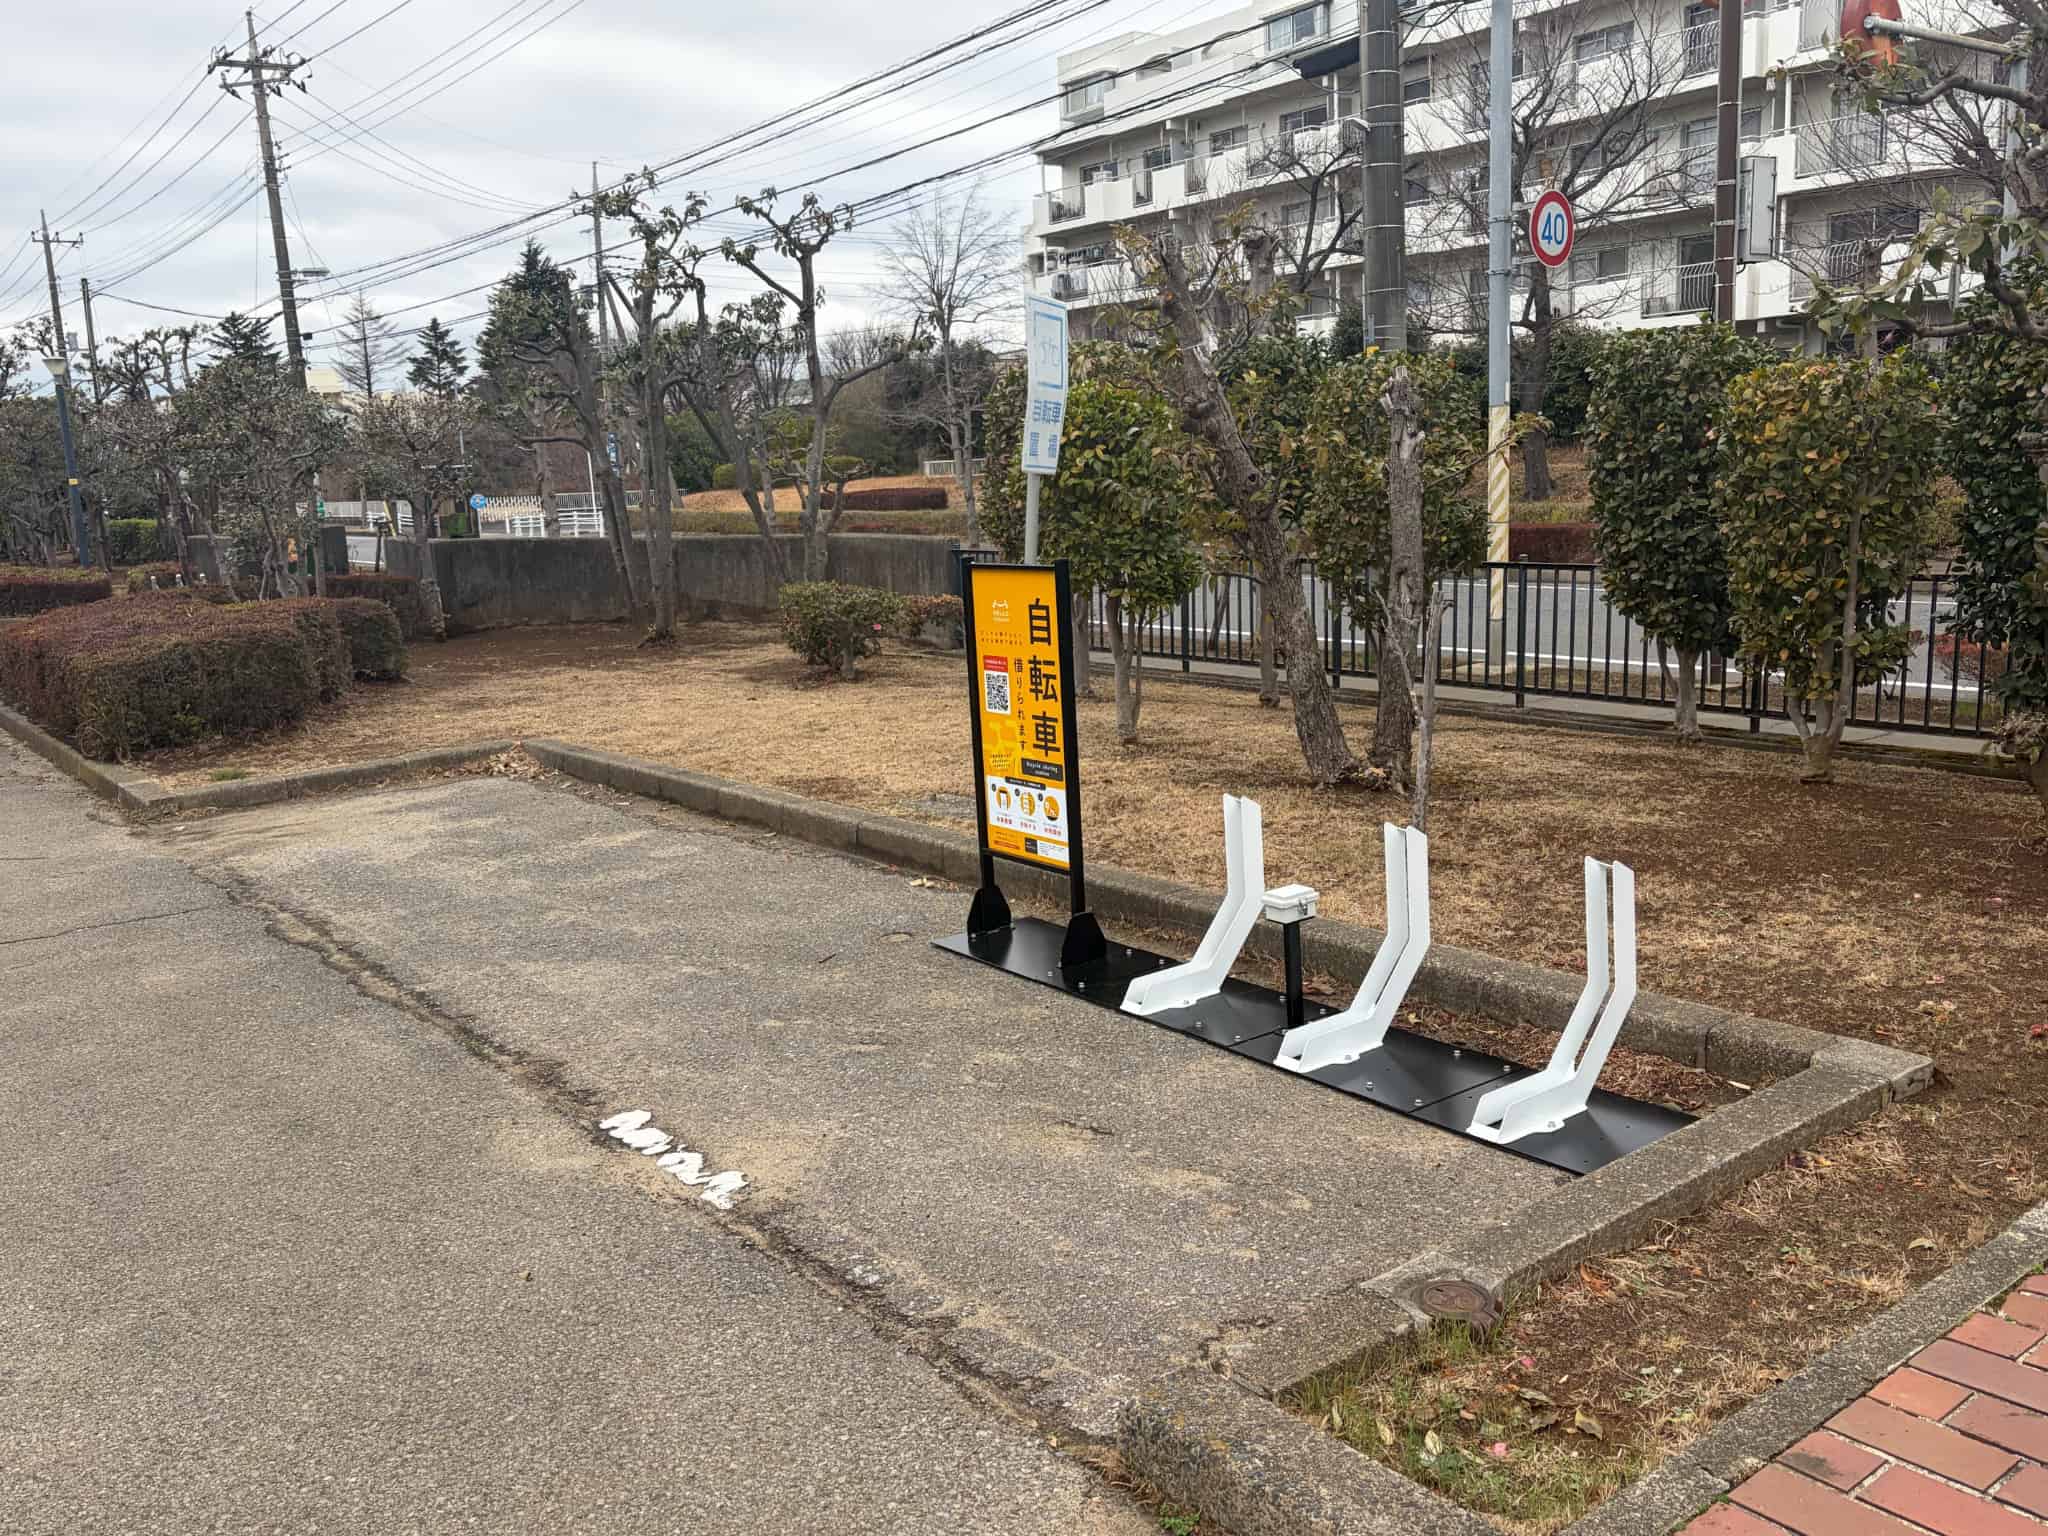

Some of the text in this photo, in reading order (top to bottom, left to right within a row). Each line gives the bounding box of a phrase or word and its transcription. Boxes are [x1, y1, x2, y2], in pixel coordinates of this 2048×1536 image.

[1541, 212, 1565, 245] 40
[1032, 399, 1062, 424] 自転車
[1014, 658, 1027, 752] 借りられます
[1028, 597, 1061, 757] 自転車
